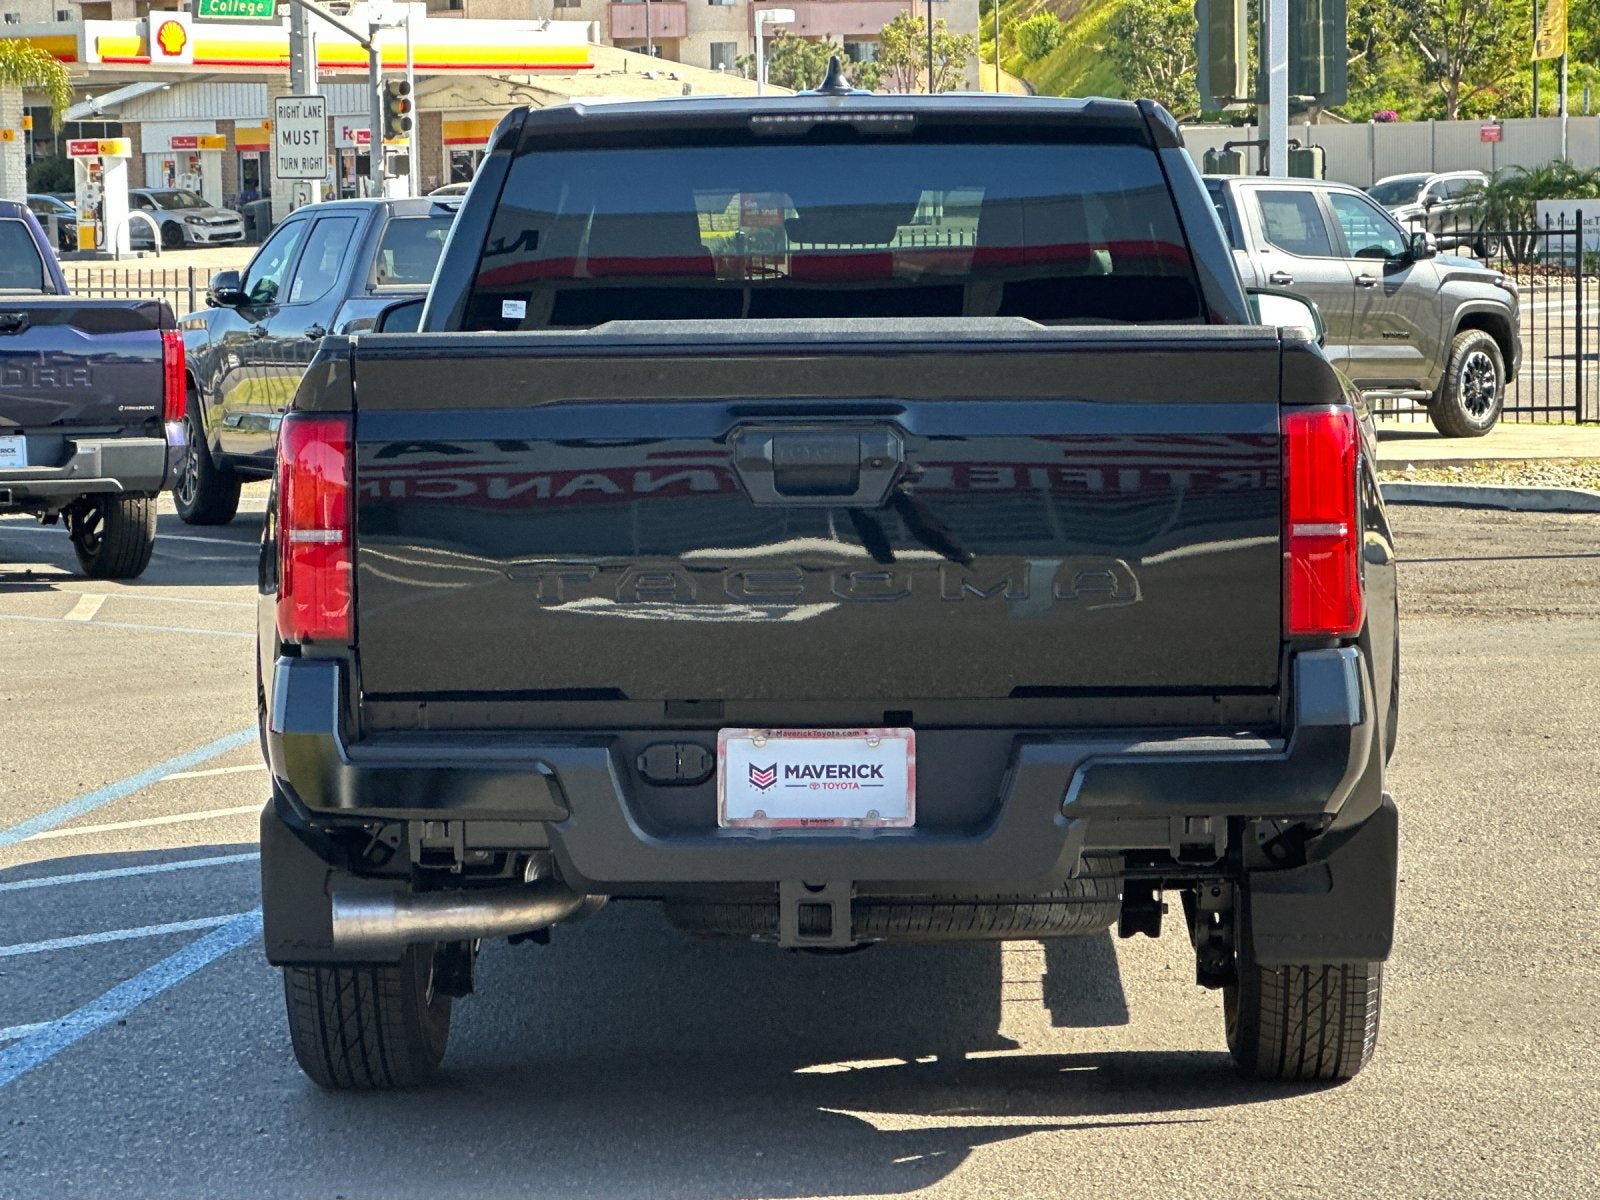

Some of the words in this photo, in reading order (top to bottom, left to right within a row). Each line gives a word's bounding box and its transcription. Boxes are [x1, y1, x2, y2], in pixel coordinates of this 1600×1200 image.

[210, 0, 264, 15] College
[278, 106, 300, 119] RIGHT
[303, 106, 323, 119] LANE
[282, 130, 320, 145] MUST
[100, 144, 106, 152] 6
[280, 157, 299, 170] TURN
[302, 157, 323, 170] RIGHT
[1557, 216, 1594, 226] HILLDE
[502, 564, 1142, 602] TACOMA
[776, 729, 860, 738] MaverickToyota.com
[785, 764, 884, 779] MAVERICK
[822, 782, 860, 790] TOYOTA
